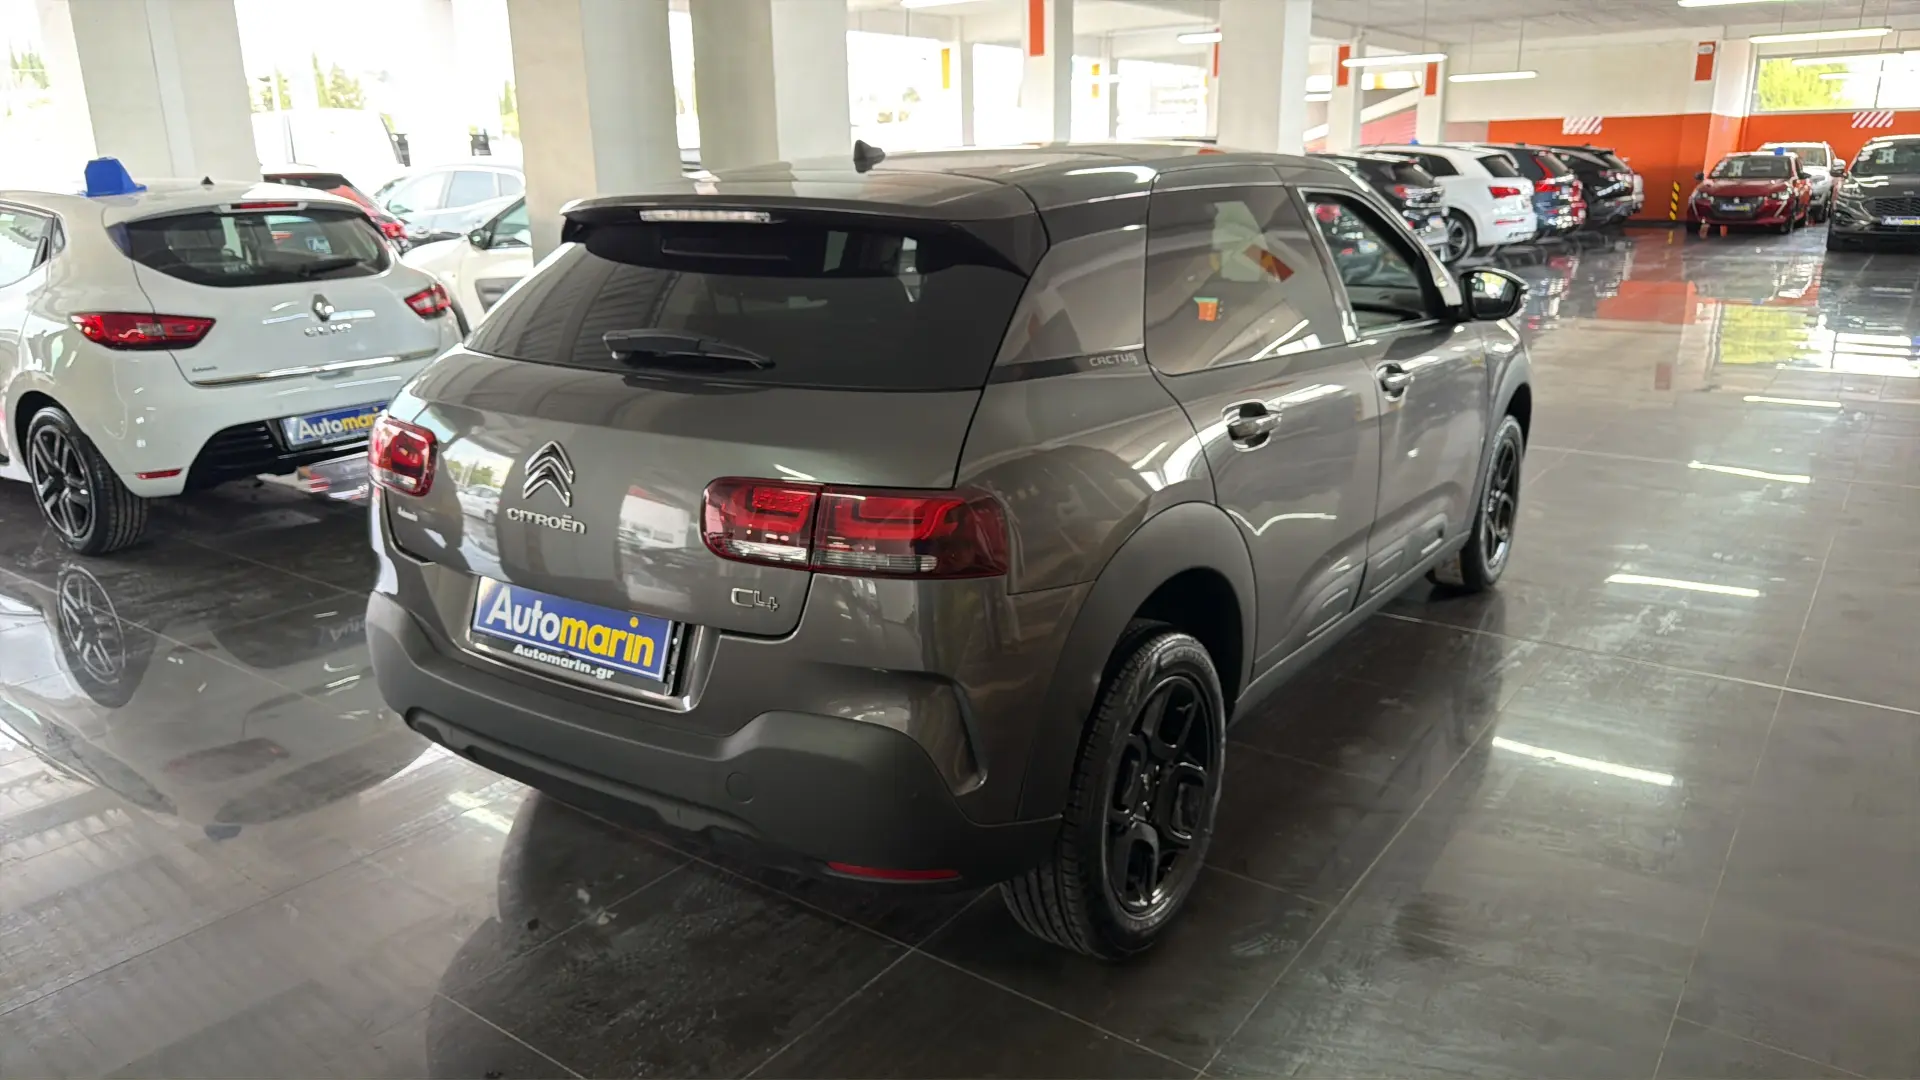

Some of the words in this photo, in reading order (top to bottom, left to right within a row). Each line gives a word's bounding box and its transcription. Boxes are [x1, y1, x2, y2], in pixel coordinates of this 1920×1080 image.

[731, 587, 778, 612] C4
[485, 585, 654, 667] Automarin
[512, 643, 615, 680] Automarin.gr
